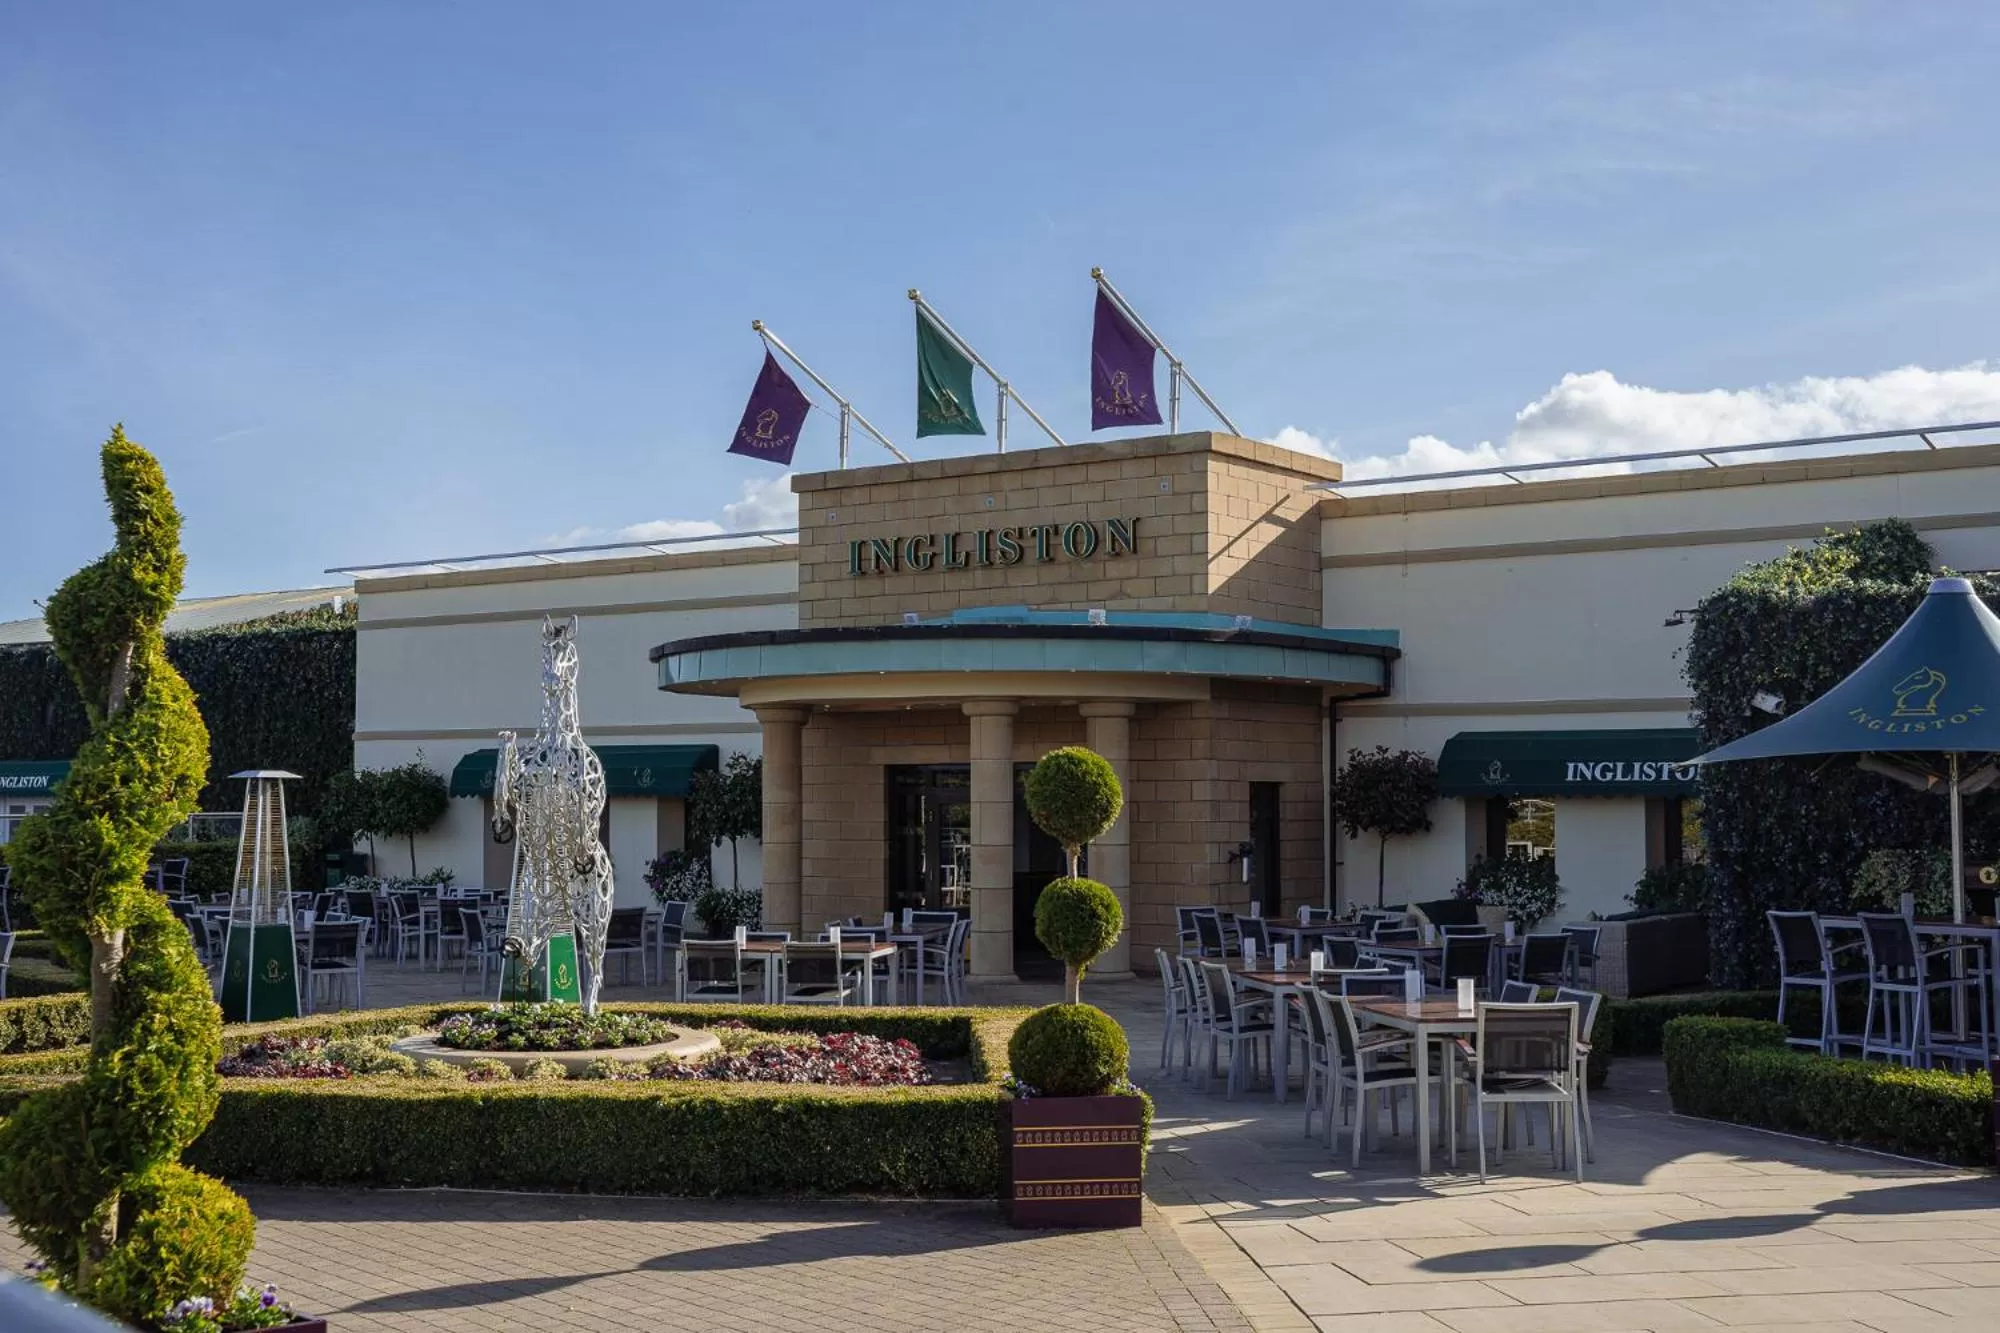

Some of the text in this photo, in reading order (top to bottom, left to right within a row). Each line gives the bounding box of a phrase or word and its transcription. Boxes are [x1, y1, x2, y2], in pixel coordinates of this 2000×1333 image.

[848, 517, 1140, 577] INGLISTON
[1849, 704, 1986, 733] INGLISTON
[0, 775, 50, 789] NGLISTON
